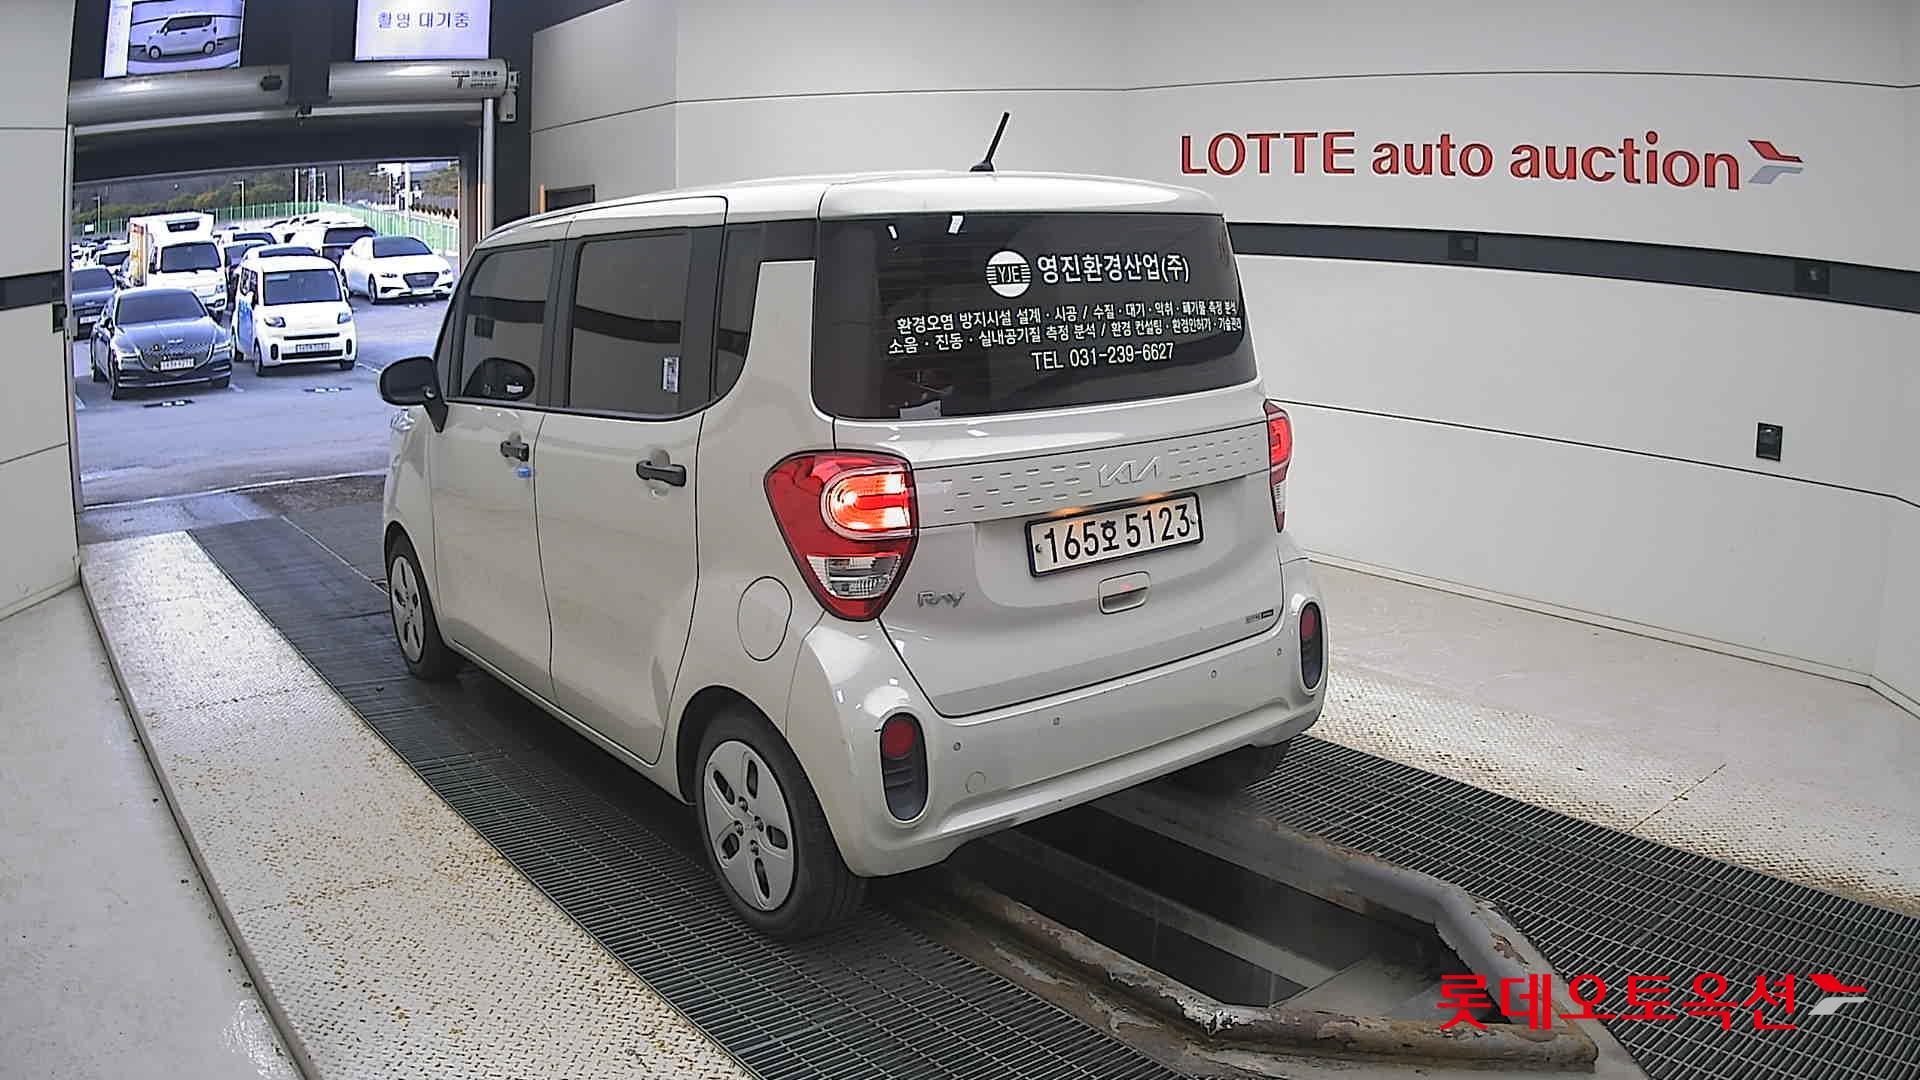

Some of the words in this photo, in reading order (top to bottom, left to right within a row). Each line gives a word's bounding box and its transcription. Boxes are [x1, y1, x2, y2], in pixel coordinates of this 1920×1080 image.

[419, 11, 470, 29] 대기중
[1180, 131, 1355, 175] LOTTE
[1371, 133, 1493, 176] auto
[1510, 130, 1740, 190] auction
[998, 265, 1020, 283] YJE
[1037, 253, 1190, 284] 영진환경산업(주)
[897, 313, 954, 335] 환경오염
[959, 309, 1012, 329] 방지시설
[1016, 306, 1041, 325] 설계
[1055, 304, 1077, 322] 시공
[1093, 303, 1115, 320] 수질
[1125, 302, 1146, 318] 대기
[1154, 301, 1173, 316] 악취
[888, 336, 919, 355] 소음
[935, 332, 963, 351] 진동
[978, 326, 1041, 348] 실내공기질
[1046, 324, 1069, 342] 측정
[1073, 322, 1096, 340] 분석
[1111, 321, 1132, 337] 환경
[1135, 319, 1163, 336] 컨설팅
[1032, 351, 1064, 370] TEL
[1069, 342, 1174, 368] 031-239-6627
[1043, 519, 1120, 564] 165호
[1125, 503, 1191, 548] 5123
